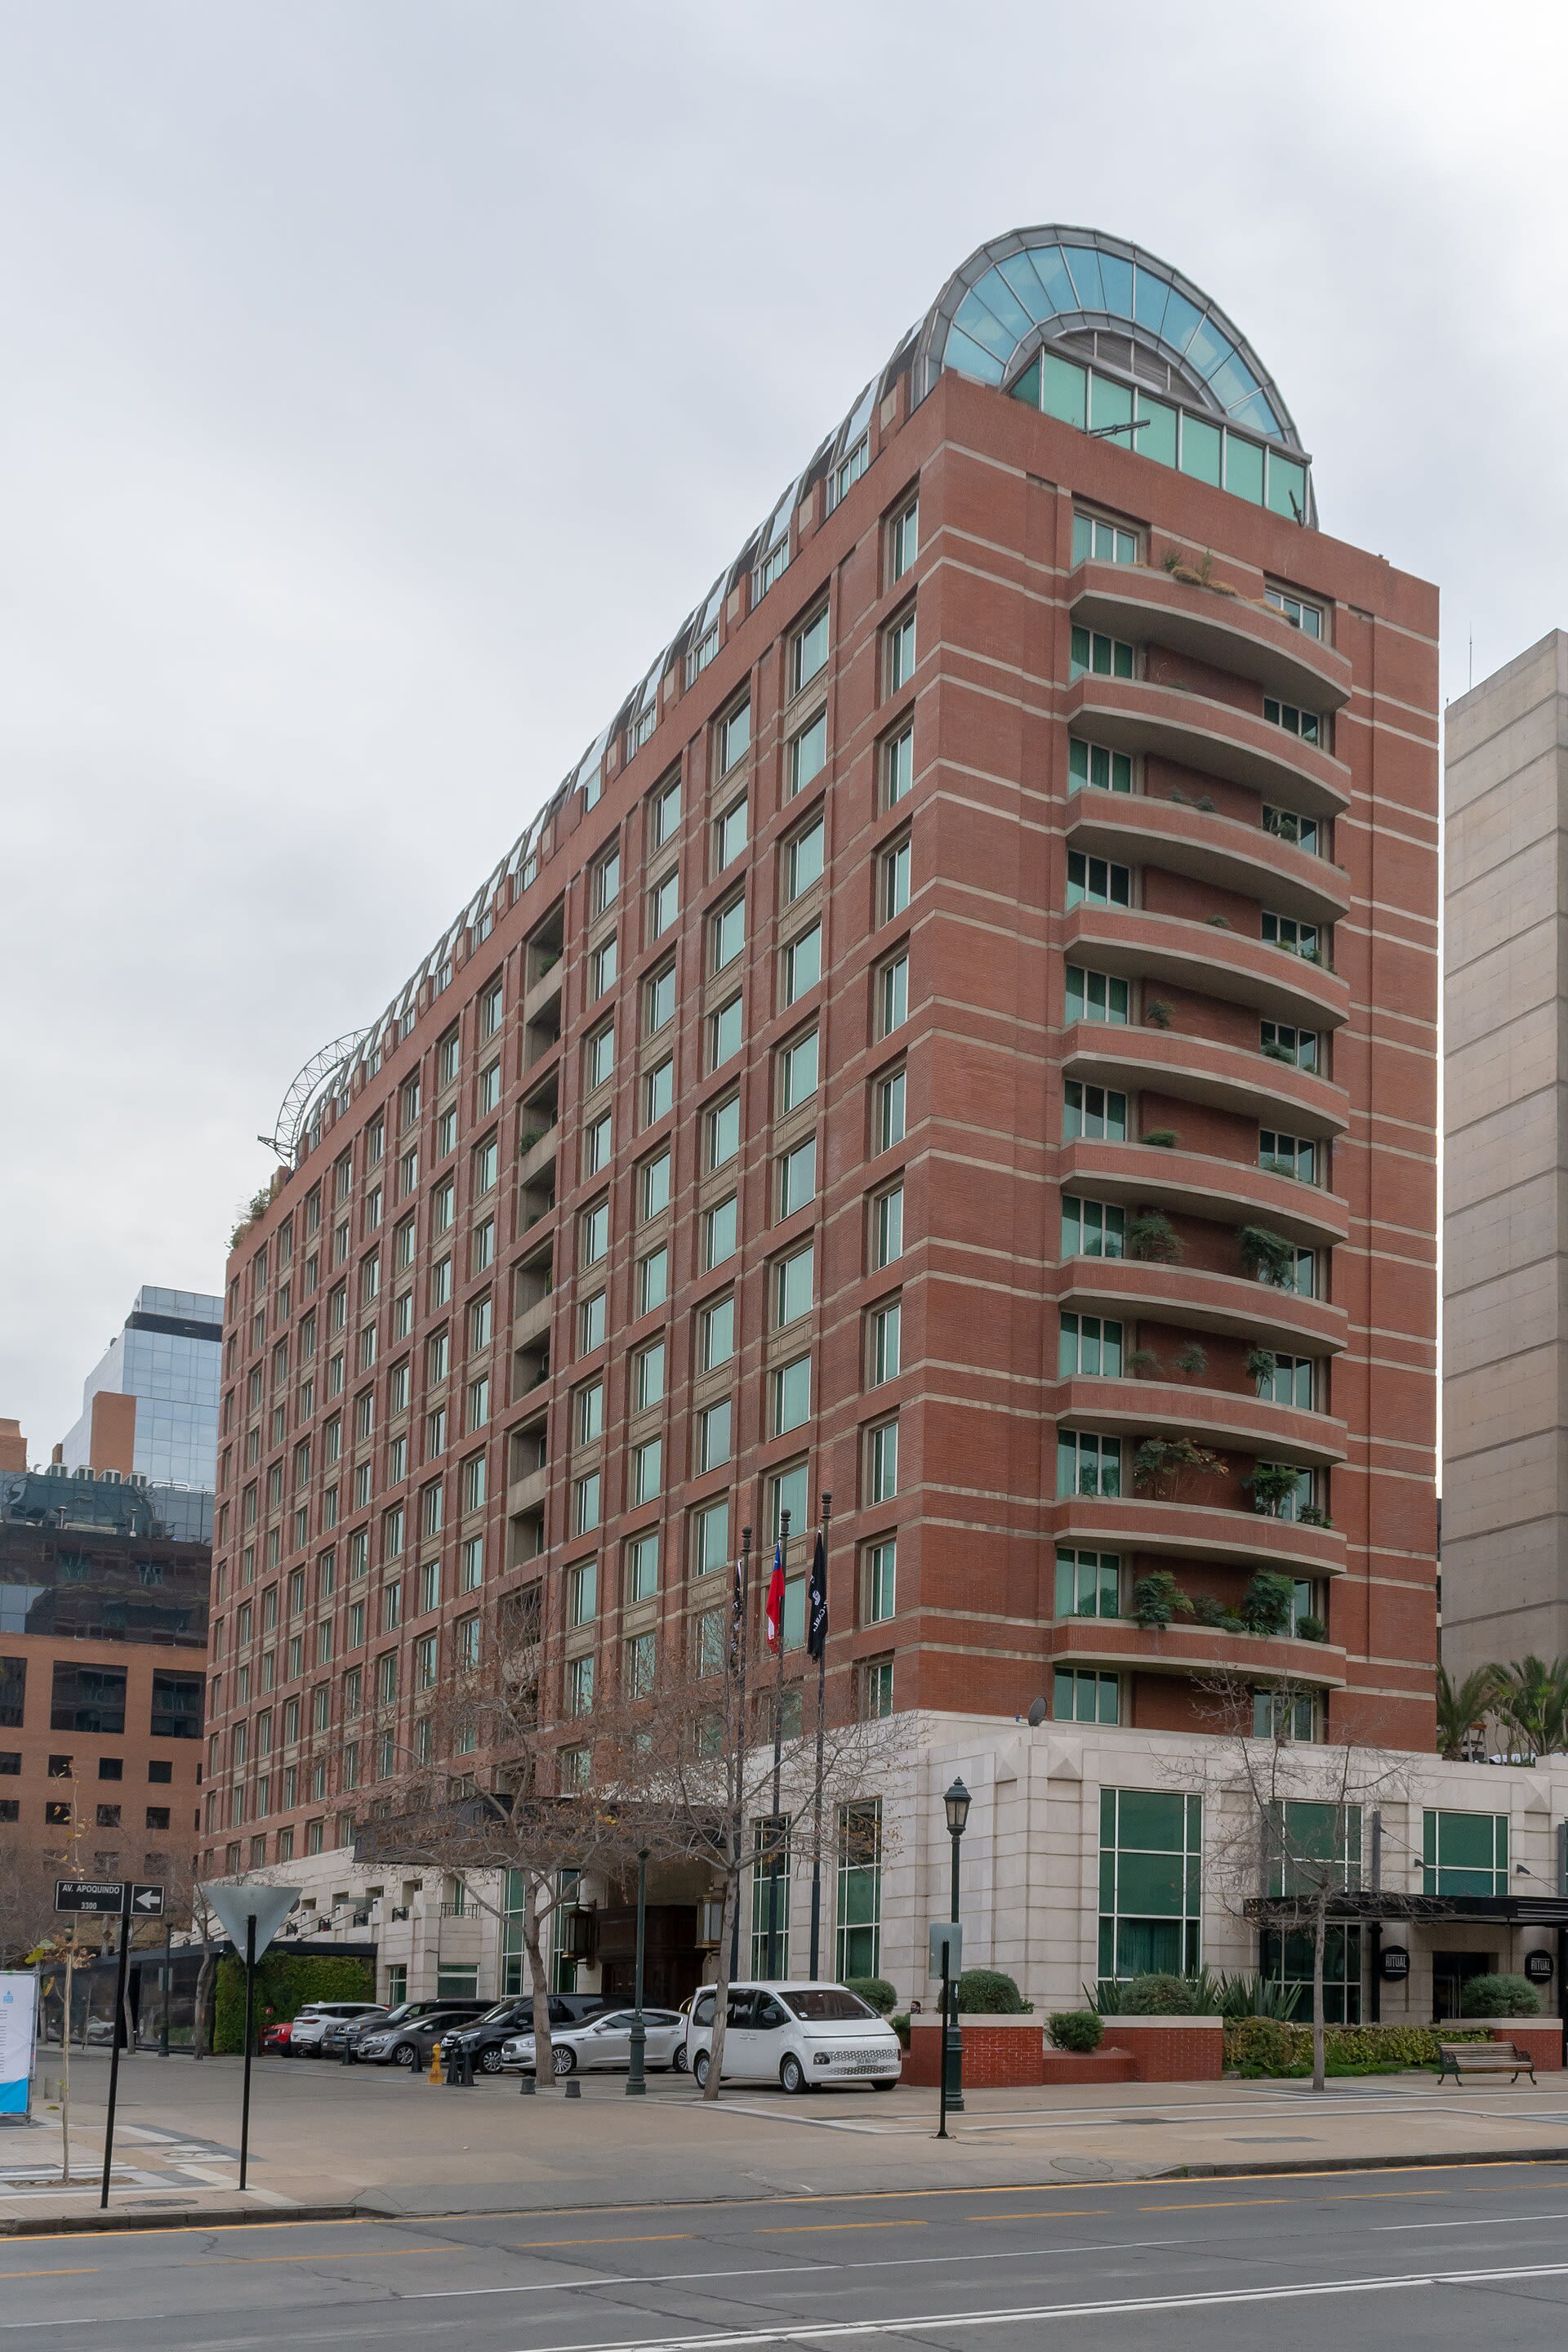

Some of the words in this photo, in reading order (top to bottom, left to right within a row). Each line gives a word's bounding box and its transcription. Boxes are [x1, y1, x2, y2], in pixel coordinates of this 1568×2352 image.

[62, 1884, 74, 1892] AV.
[76, 1885, 120, 1894] APOQUINDO
[1386, 1956, 1406, 1967] RITUAL
[1531, 1960, 1551, 1971] RITUAL
